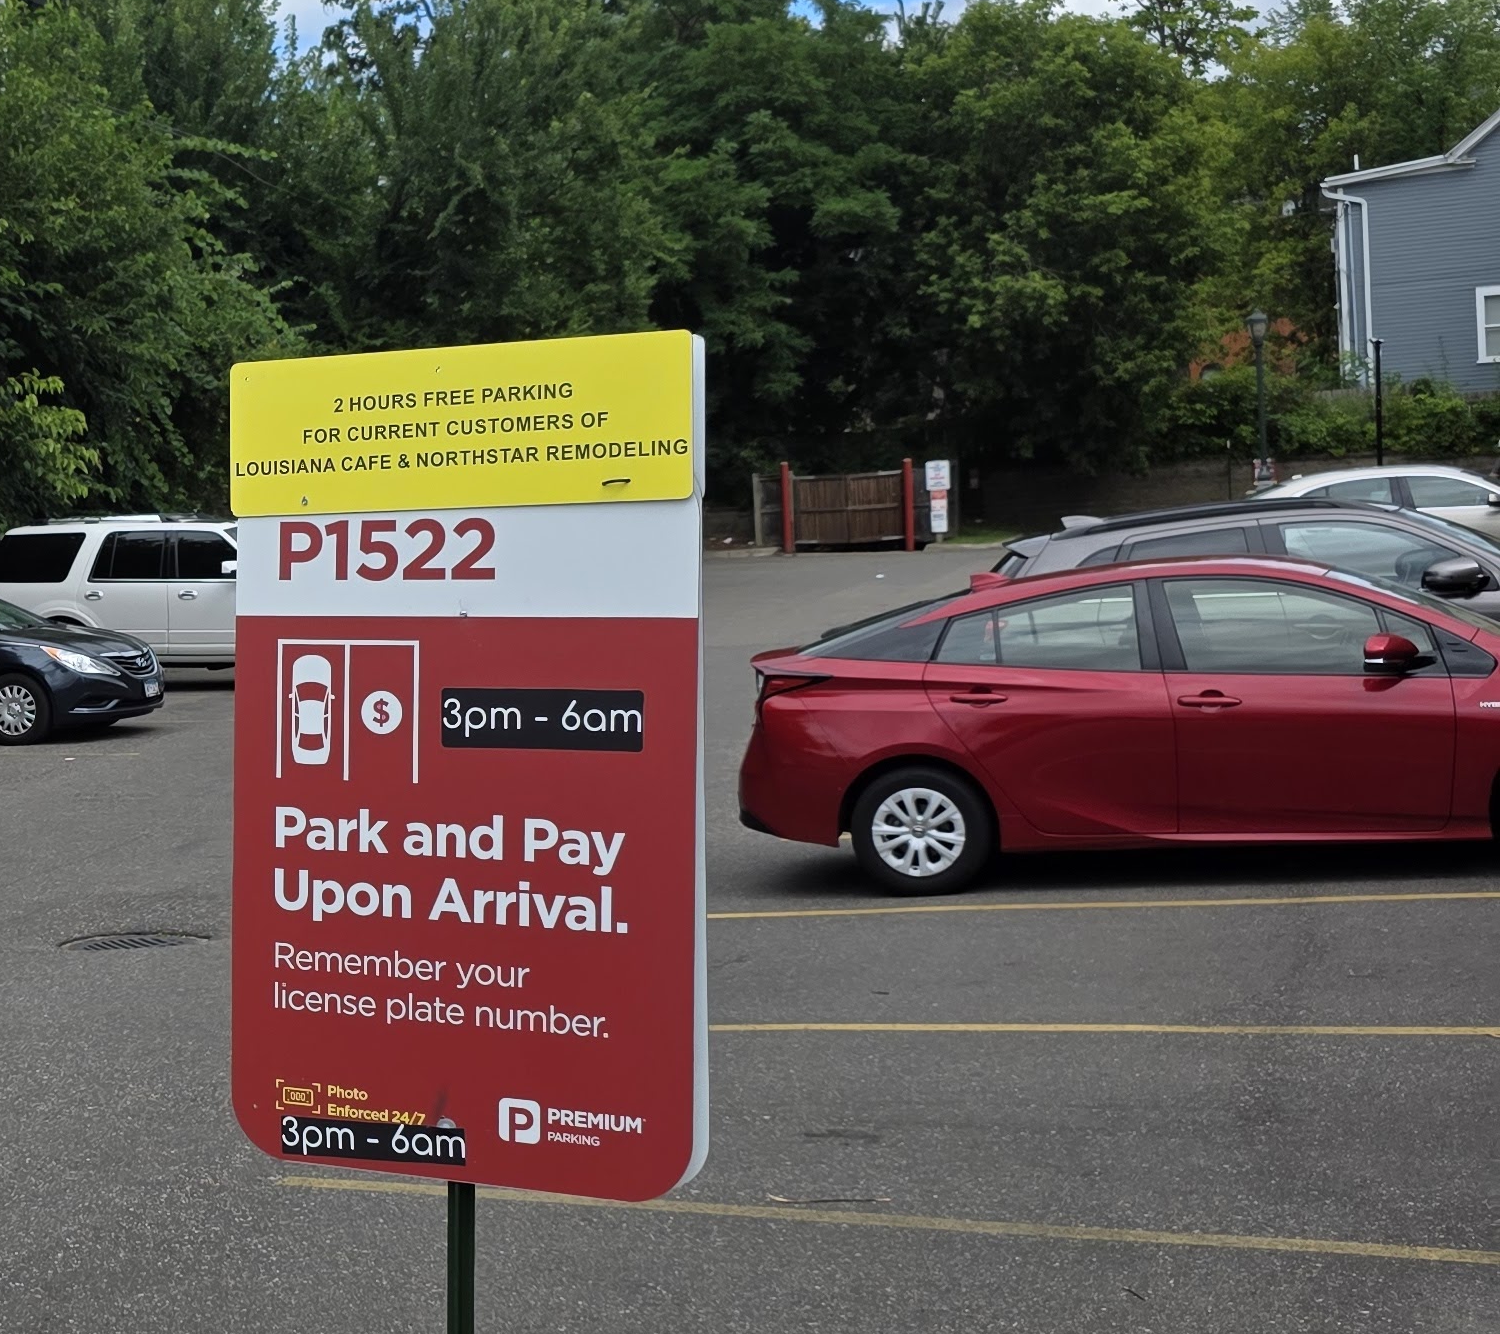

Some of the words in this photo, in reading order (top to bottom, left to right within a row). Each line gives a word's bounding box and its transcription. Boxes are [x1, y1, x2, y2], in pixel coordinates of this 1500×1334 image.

[333, 397, 344, 413] 2
[349, 392, 417, 412] HOURS
[423, 388, 475, 407] FREE
[482, 382, 573, 404] PARKING
[303, 427, 341, 445] FOR
[347, 421, 441, 442] CURRENT
[446, 413, 574, 436] CUSTOMERS
[580, 411, 609, 429] OF
[235, 457, 336, 477] LOUISIANA
[341, 454, 392, 472] CAFE
[397, 453, 411, 469] &
[416, 446, 540, 468] NORTHSTAR
[546, 438, 688, 462] REMODELING
[278, 517, 496, 582] P1522
[442, 697, 522, 737] 3pm
[561, 699, 642, 733] 6am
[275, 806, 389, 854] Park
[403, 814, 504, 861] and
[524, 817, 626, 876] Pay
[274, 867, 412, 922] Upon
[428, 877, 628, 934] Arrival.
[274, 941, 447, 981] Remember
[455, 962, 531, 989] your
[274, 981, 377, 1017] license
[386, 992, 465, 1025] plate
[475, 1004, 609, 1039] number.
[327, 1084, 369, 1101] Photo
[327, 1103, 389, 1122] Enforced
[391, 1110, 426, 1125] 24/7
[547, 1107, 642, 1134] PREMIUM
[281, 1115, 355, 1155] 3pm
[391, 1124, 466, 1159] 6am
[547, 1131, 601, 1147] PARKING
